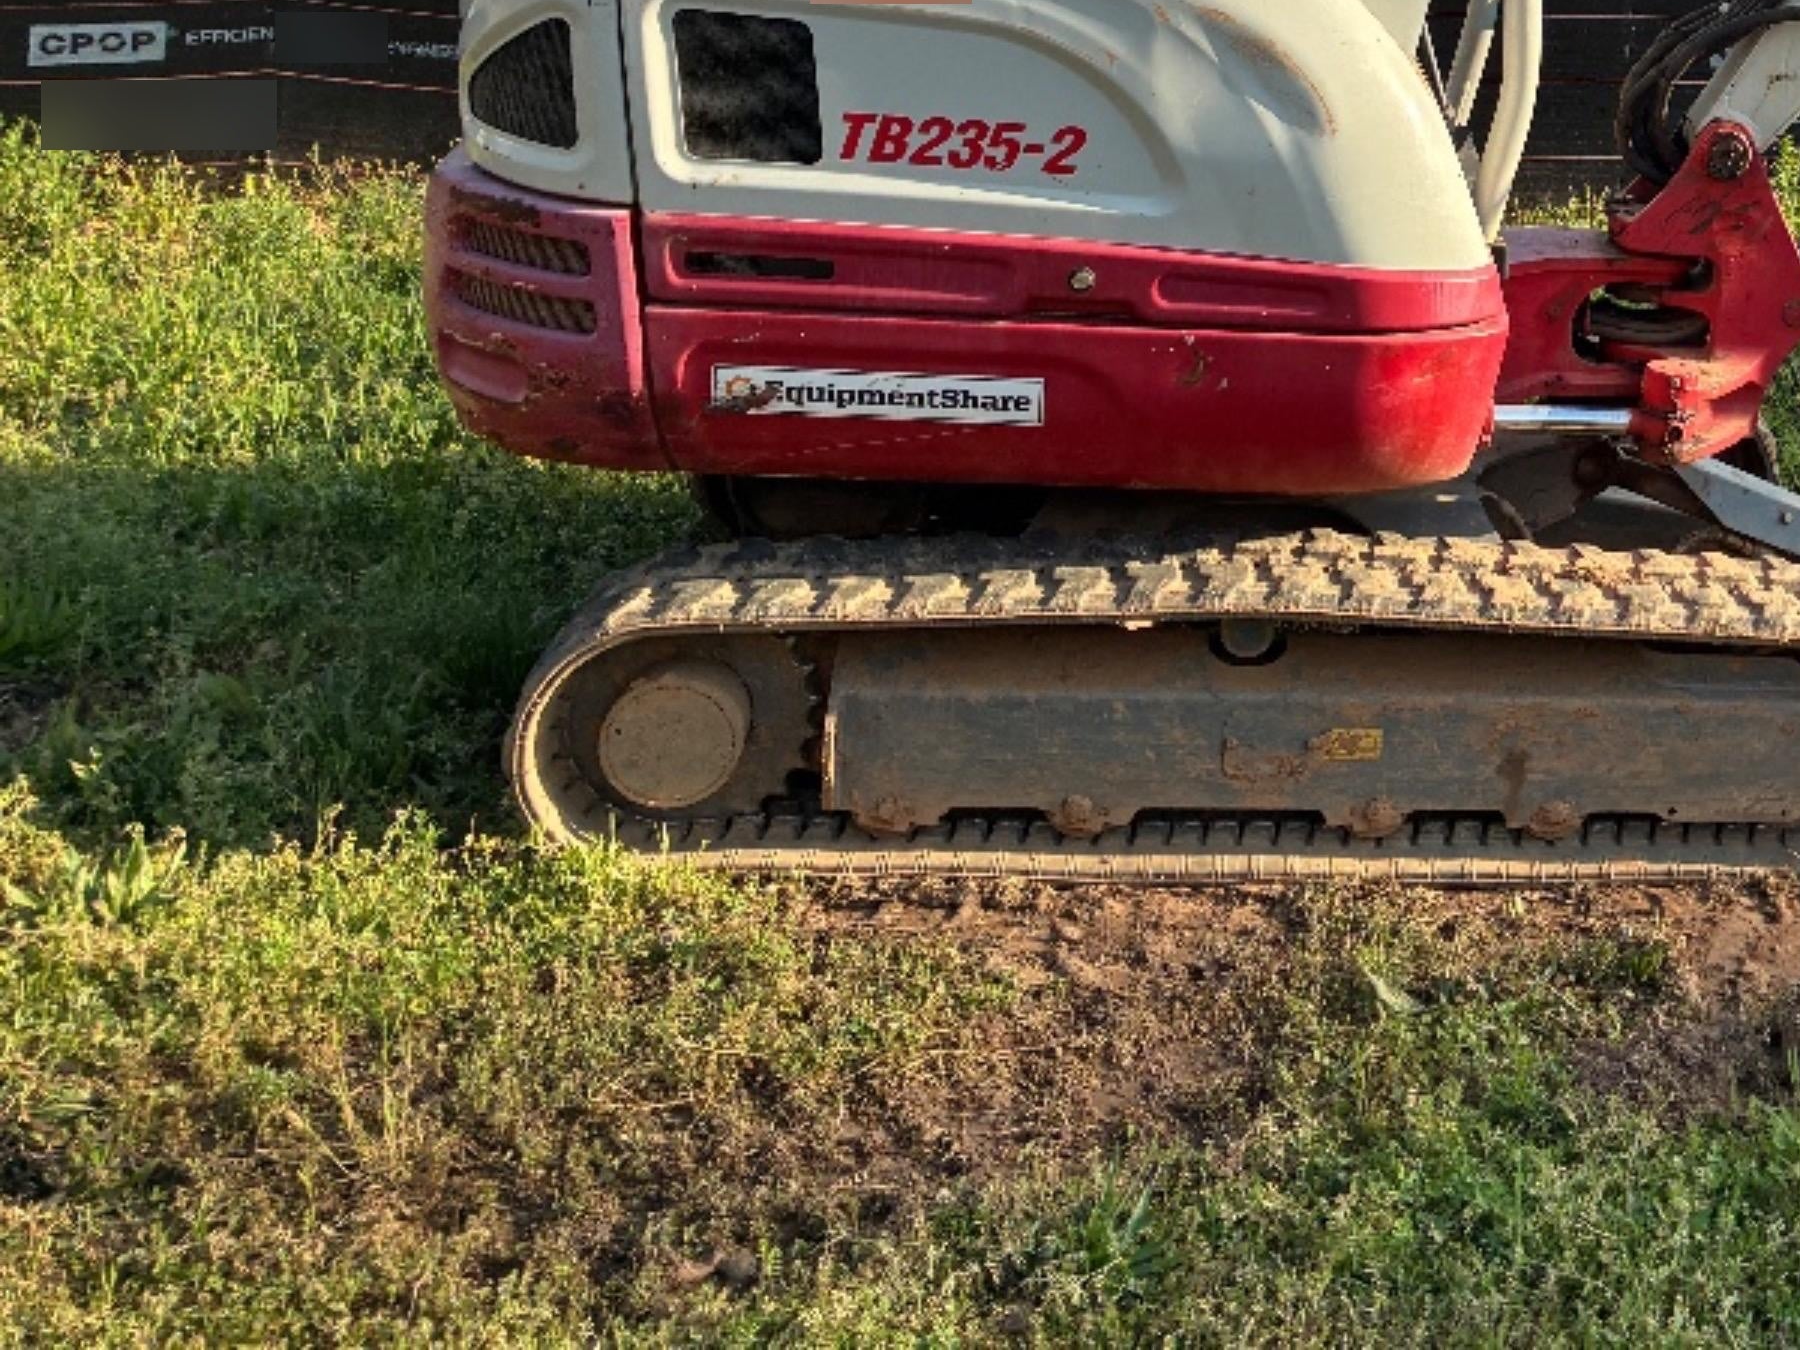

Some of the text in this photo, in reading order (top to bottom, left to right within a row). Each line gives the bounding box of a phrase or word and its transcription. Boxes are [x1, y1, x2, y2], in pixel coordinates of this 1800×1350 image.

[36, 28, 159, 57] CPOP
[839, 112, 1087, 175] TB235-2
[763, 380, 1030, 413] EquipmentShare
